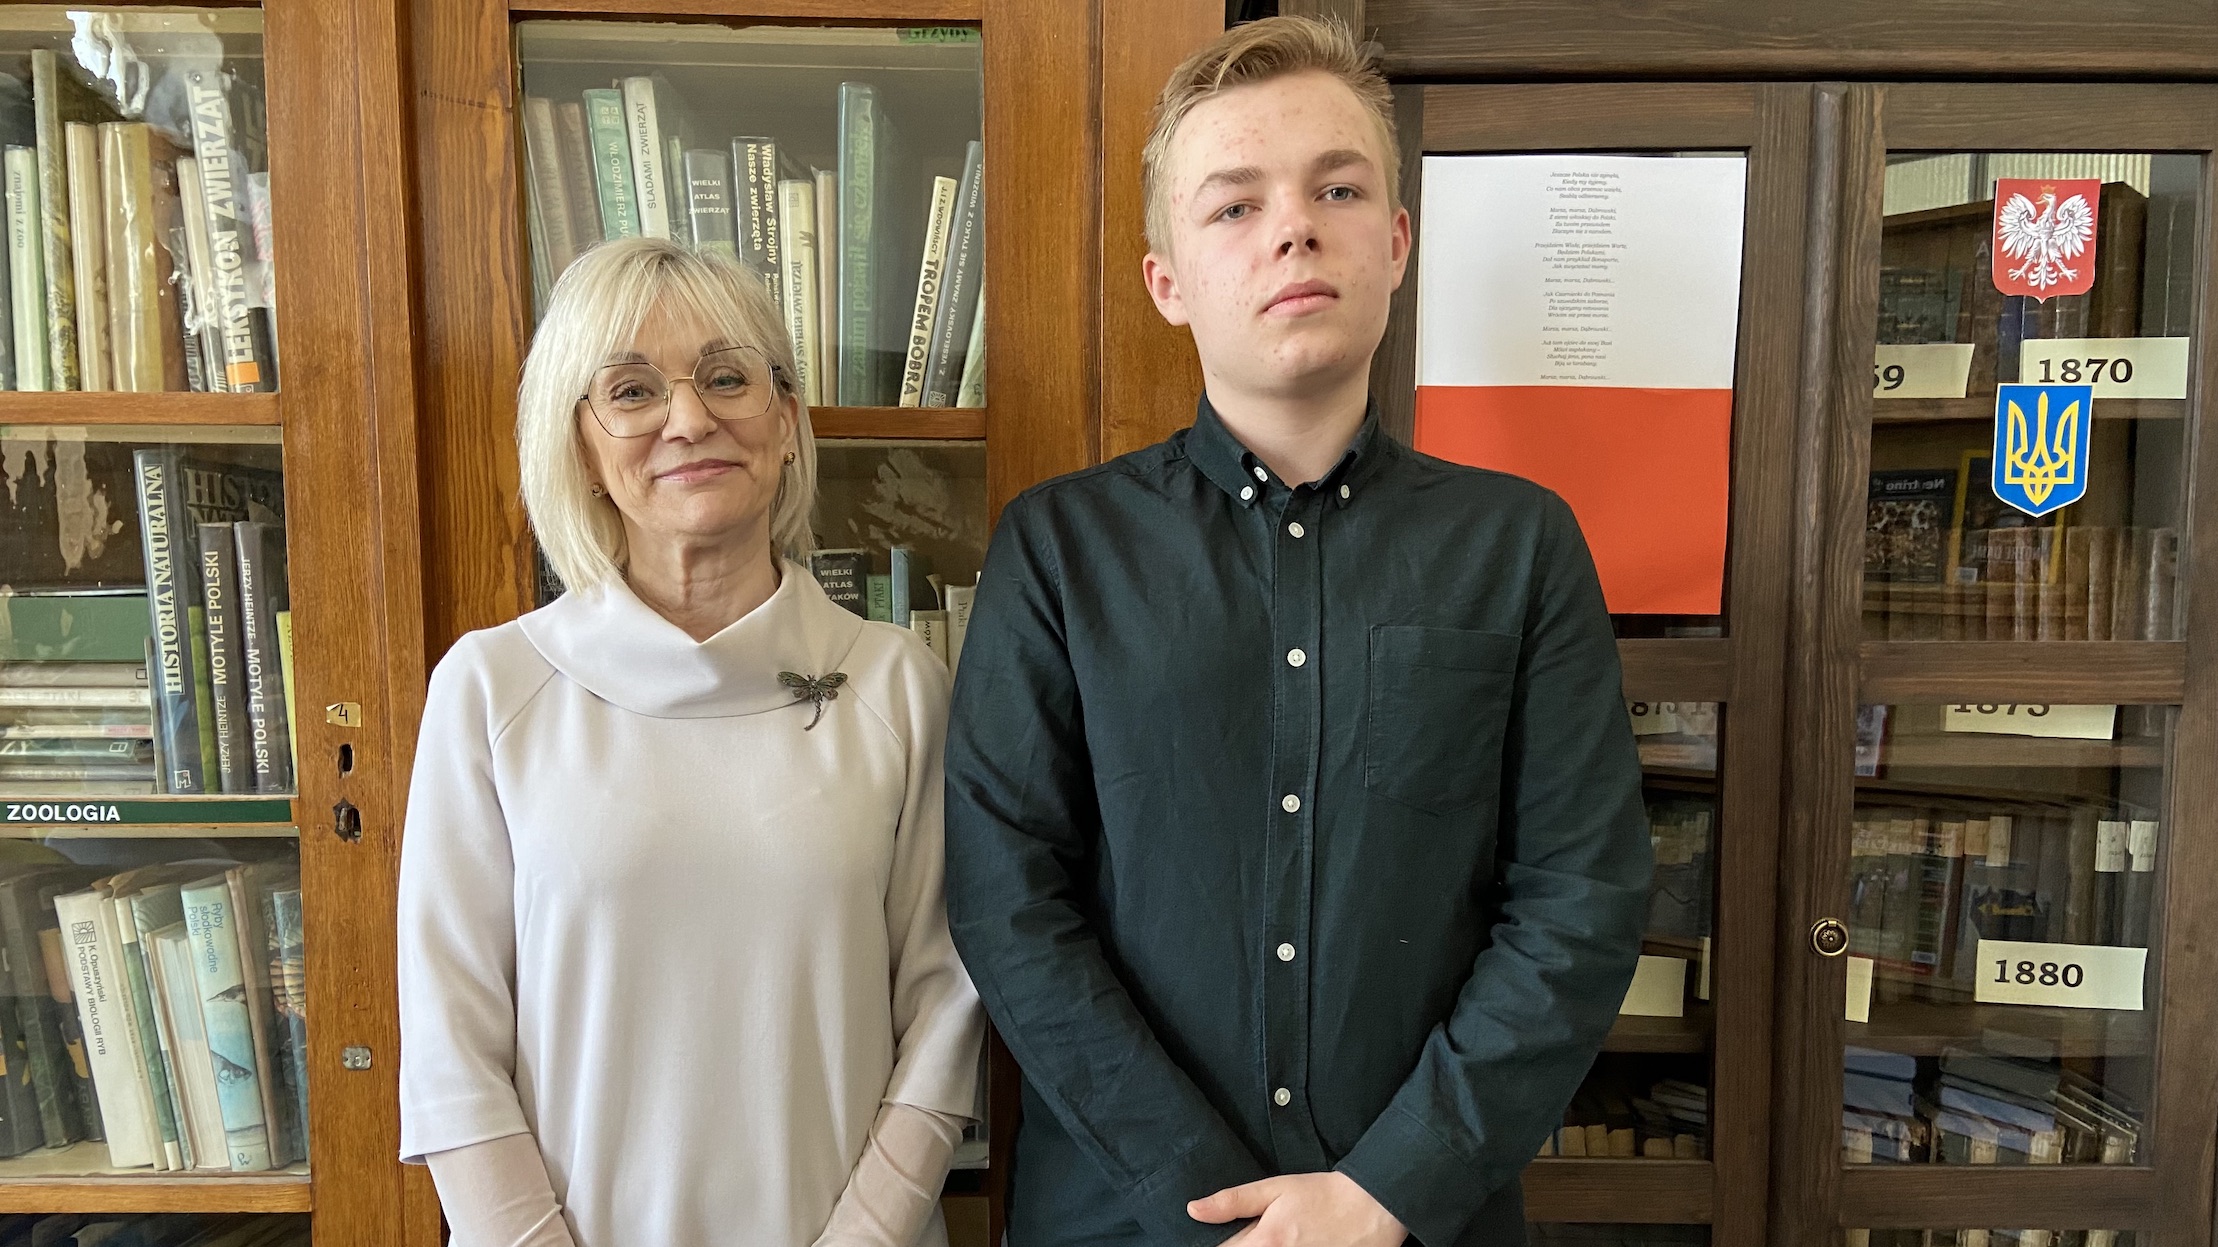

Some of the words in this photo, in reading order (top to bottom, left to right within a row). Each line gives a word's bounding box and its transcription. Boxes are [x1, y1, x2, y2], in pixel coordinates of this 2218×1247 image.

[636, 102, 650, 155] ZWIERZĄT
[747, 143, 757, 182] Nasze
[761, 143, 774, 213] Władysław
[969, 163, 983, 208] WIDZENIA
[750, 187, 762, 250] zwierzęta
[961, 221, 973, 250] TYLKO
[967, 211, 974, 219] Z
[766, 217, 779, 265] Strojny
[211, 231, 254, 362] LEKSYKON
[915, 259, 939, 332] TROPEM
[952, 269, 964, 303] ZNAMY
[903, 335, 927, 395] BOBRA
[2038, 358, 2134, 384] 1870
[144, 465, 173, 587] NATURALNA
[204, 551, 222, 610] POLSKI
[241, 559, 252, 588] JERZY
[875, 582, 885, 608] PTAKI
[243, 593, 256, 638] HEINTZE
[156, 589, 183, 694] HISTORIA
[209, 615, 227, 685] MOTYLE
[247, 649, 264, 713] MOTYLE
[216, 695, 230, 738] HEINTZE
[338, 703, 349, 725] 4
[219, 742, 231, 773] JERZY
[252, 718, 270, 774] POLSKI
[6, 804, 121, 822] ZOOLOGIA
[188, 906, 200, 936] Polski
[212, 902, 224, 929] Ryby
[200, 906, 218, 974] słodkowodne
[1993, 958, 2085, 989] 1880
[77, 946, 95, 996] PODSTAWY
[87, 997, 102, 1037] BIOLOGII
[95, 1037, 106, 1056] RYB
